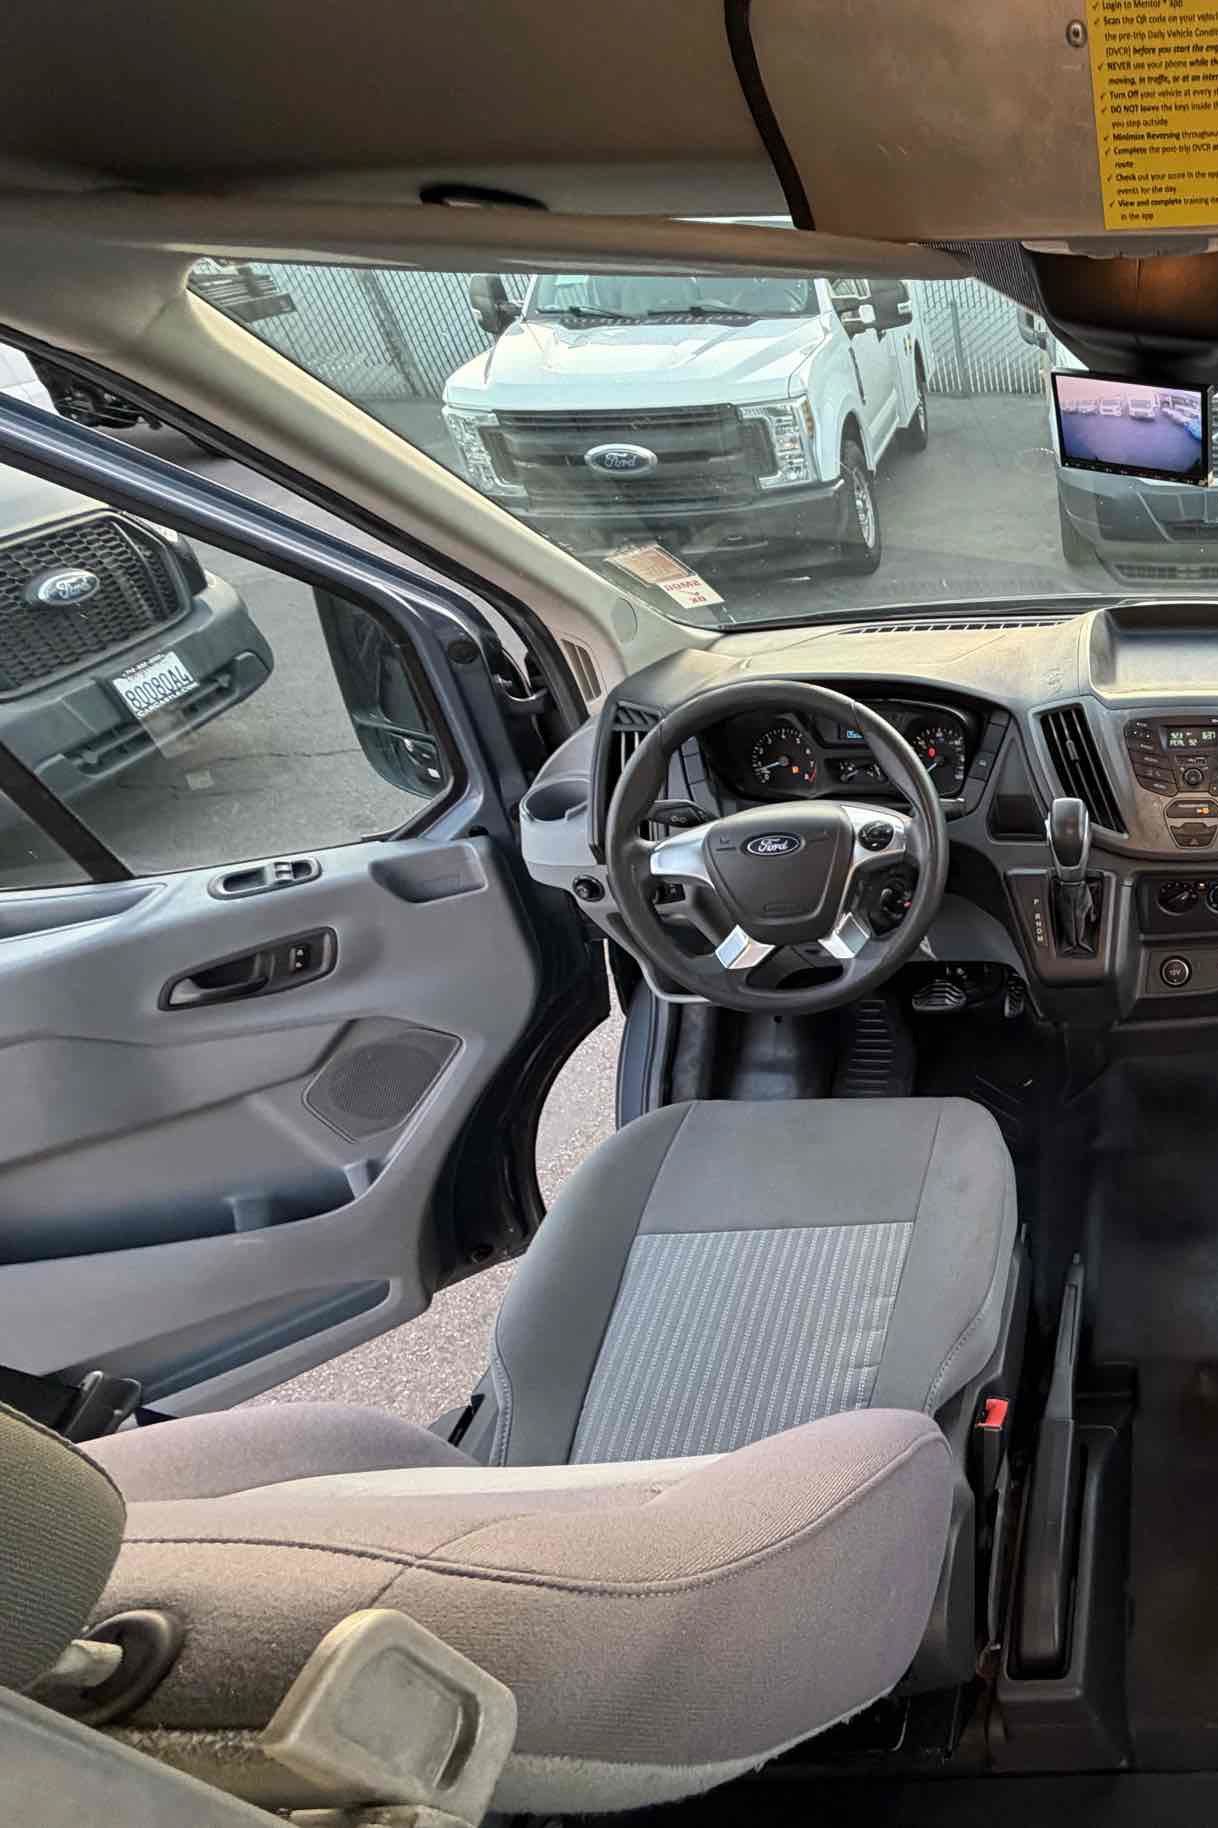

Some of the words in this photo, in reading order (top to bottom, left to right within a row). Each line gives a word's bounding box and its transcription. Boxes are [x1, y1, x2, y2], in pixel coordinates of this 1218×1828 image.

[1104, 16, 1120, 24] Scan
[1122, 15, 1134, 24] the
[1149, 14, 1166, 23] code
[1180, 15, 1196, 24] your
[1105, 32, 1117, 40] the
[1148, 30, 1165, 40] Daily
[1167, 29, 1194, 38] Vehicle
[1133, 45, 1156, 54] before
[1158, 46, 1172, 55] you
[1174, 44, 1190, 53] start
[1192, 44, 1204, 52] the
[1108, 61, 1132, 70] NEVER
[1147, 61, 1163, 70] your
[1165, 59, 1187, 69] phone
[1189, 58, 1209, 67] while
[1110, 90, 1126, 99] Turn
[1128, 90, 1138, 98] Off
[1140, 90, 1156, 99] your
[1158, 88, 1182, 97] vehicle
[1193, 88, 1212, 97] every
[1111, 104, 1122, 113] DO
[1124, 104, 1138, 112] NOT
[1140, 103, 1160, 112] leave
[1161, 102, 1173, 111] the
[1175, 102, 1189, 112] keys
[1191, 101, 1212, 110] inside
[1112, 120, 1124, 128] you
[1126, 118, 1141, 128] step
[1142, 117, 1168, 125] outside
[1114, 145, 1147, 156] Complete
[1115, 159, 1134, 168] route
[1116, 172, 1136, 181] Check
[1138, 172, 1150, 180] out
[1151, 172, 1166, 181] your
[1195, 169, 1206, 178] the
[1118, 185, 1139, 194] events
[1152, 184, 1163, 193] the
[1164, 184, 1176, 194] day
[1118, 198, 1136, 206] View
[1137, 197, 1150, 206] and
[1151, 196, 1182, 207] complete
[758, 838, 789, 852] Ford
